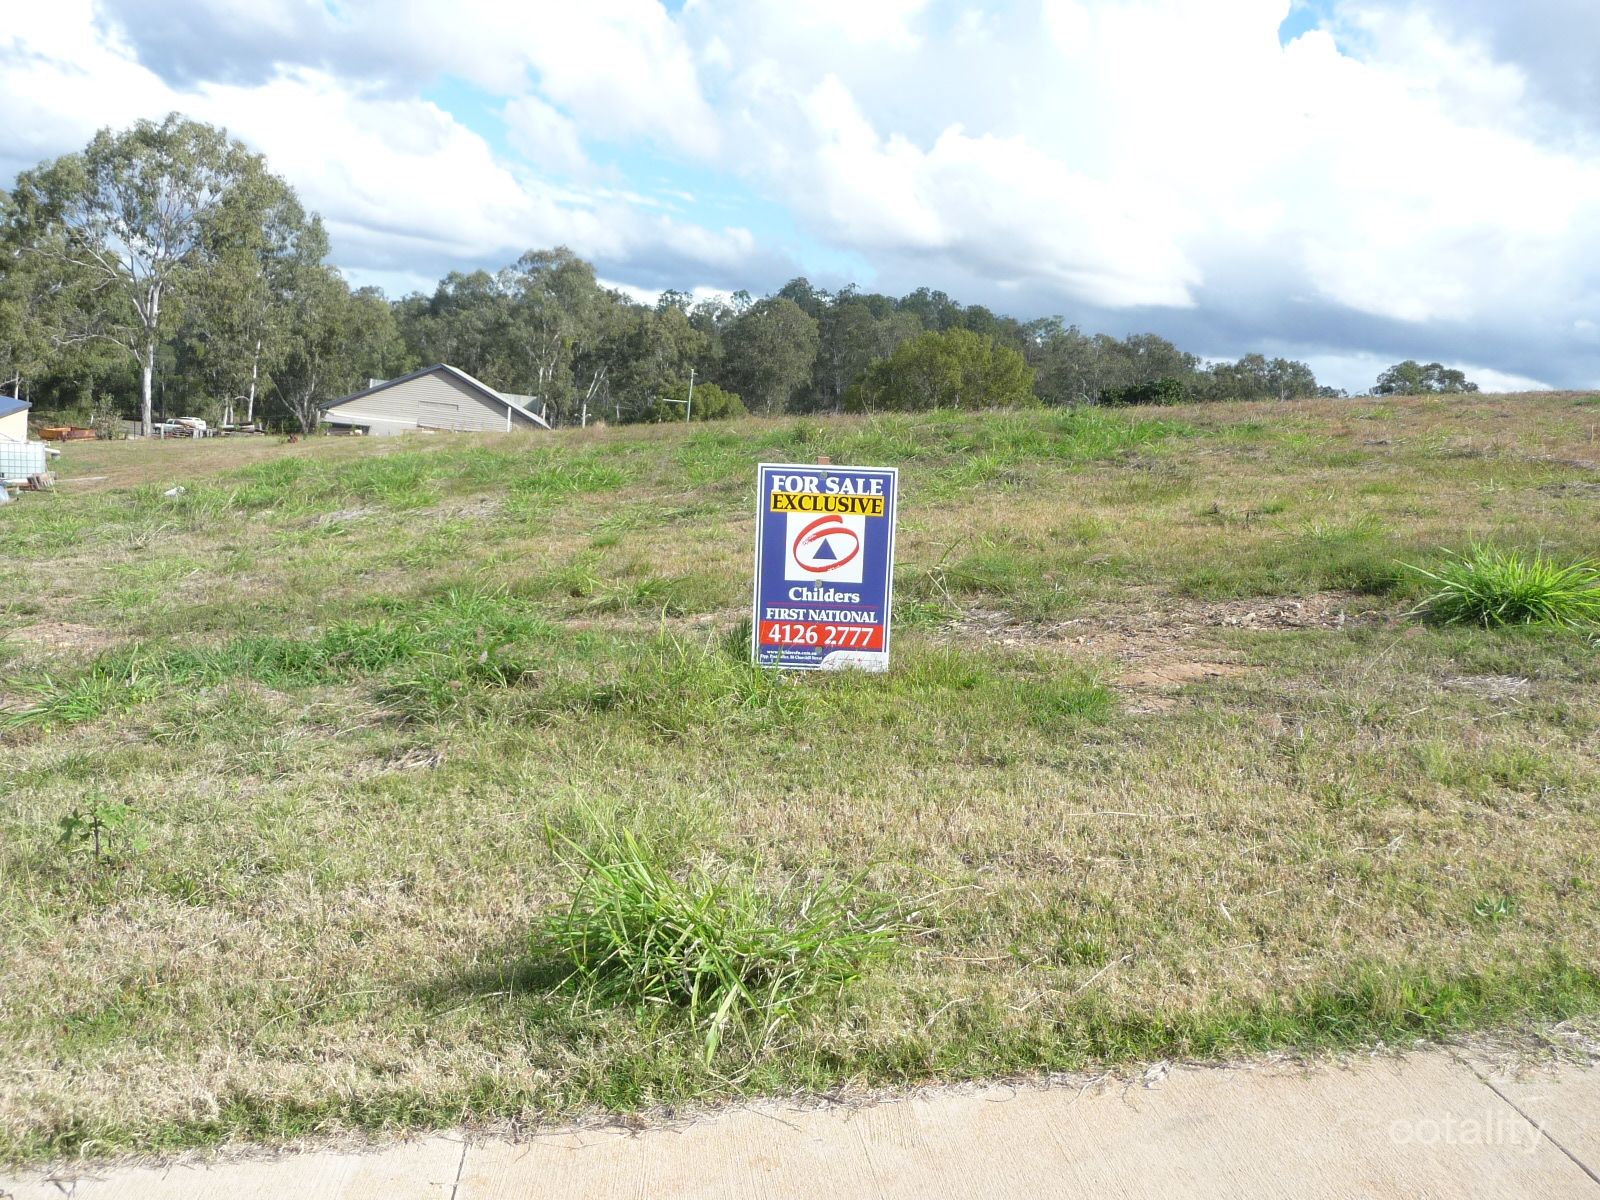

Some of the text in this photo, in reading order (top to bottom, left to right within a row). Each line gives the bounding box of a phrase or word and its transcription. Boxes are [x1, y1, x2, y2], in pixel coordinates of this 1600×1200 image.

[772, 475, 883, 495] FOR SALE
[772, 493, 882, 514] EXCLUSIVE
[788, 587, 860, 603] Childers
[766, 608, 877, 623] FIRST NATIONAL
[768, 624, 874, 646] 4126 2777
